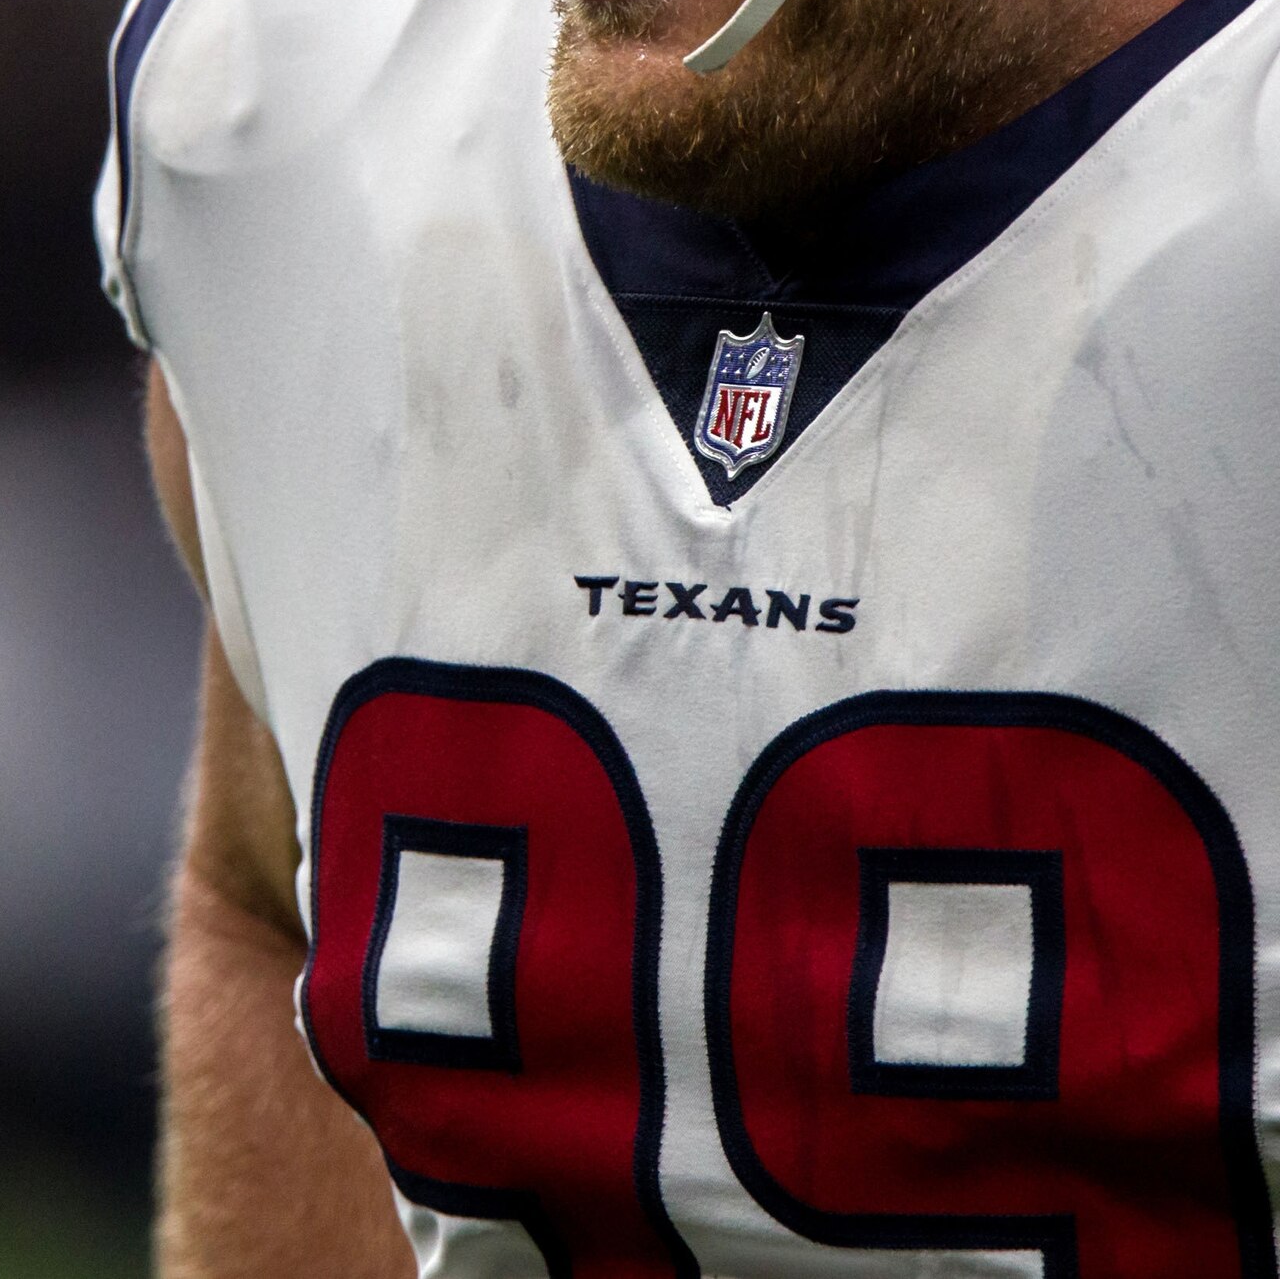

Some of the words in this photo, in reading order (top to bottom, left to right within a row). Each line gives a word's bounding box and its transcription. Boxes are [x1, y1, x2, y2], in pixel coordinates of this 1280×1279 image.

[709, 388, 773, 449] NFL
[573, 574, 861, 634] TEXANS
[303, 657, 1278, 1279] 99
